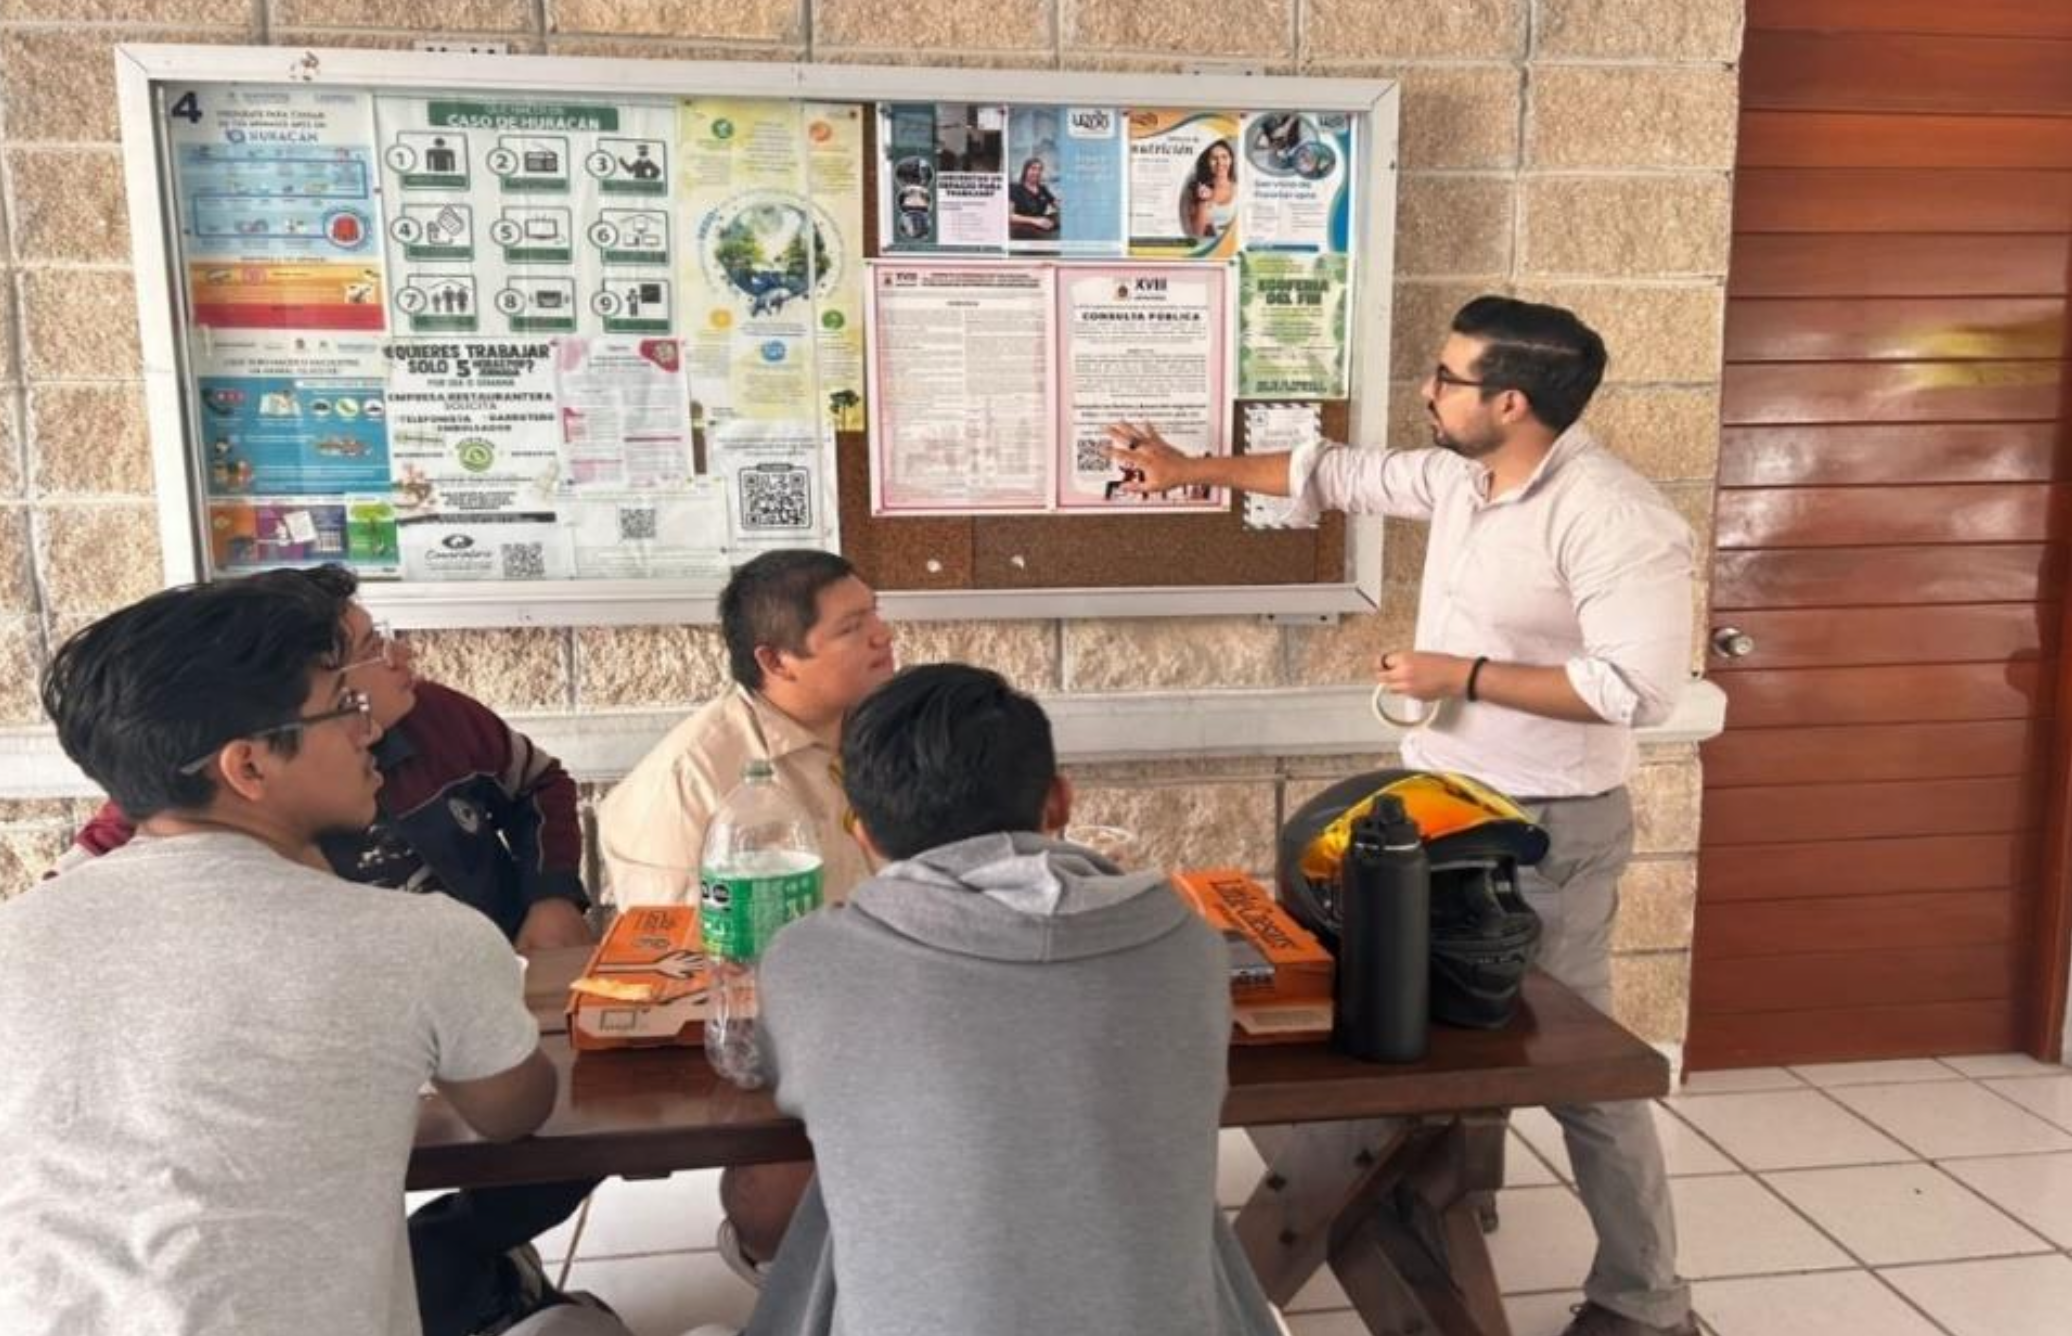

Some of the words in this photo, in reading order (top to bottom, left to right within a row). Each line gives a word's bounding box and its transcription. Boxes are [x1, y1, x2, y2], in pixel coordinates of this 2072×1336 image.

[171, 91, 203, 124] 4
[446, 113, 493, 128] CASO
[496, 116, 519, 129] DE
[396, 151, 405, 167] 1
[496, 152, 508, 169] 2
[597, 154, 608, 171] 3
[399, 222, 412, 237] 4
[500, 224, 513, 240] 5
[597, 227, 609, 242] 6
[404, 293, 416, 309] 7
[504, 294, 516, 309] 8
[600, 296, 611, 312] 9
[1082, 312, 1145, 321] CONSULTA
[464, 344, 550, 359] TRABAJAR
[408, 360, 449, 374] SOLO
[456, 360, 471, 377] 5
